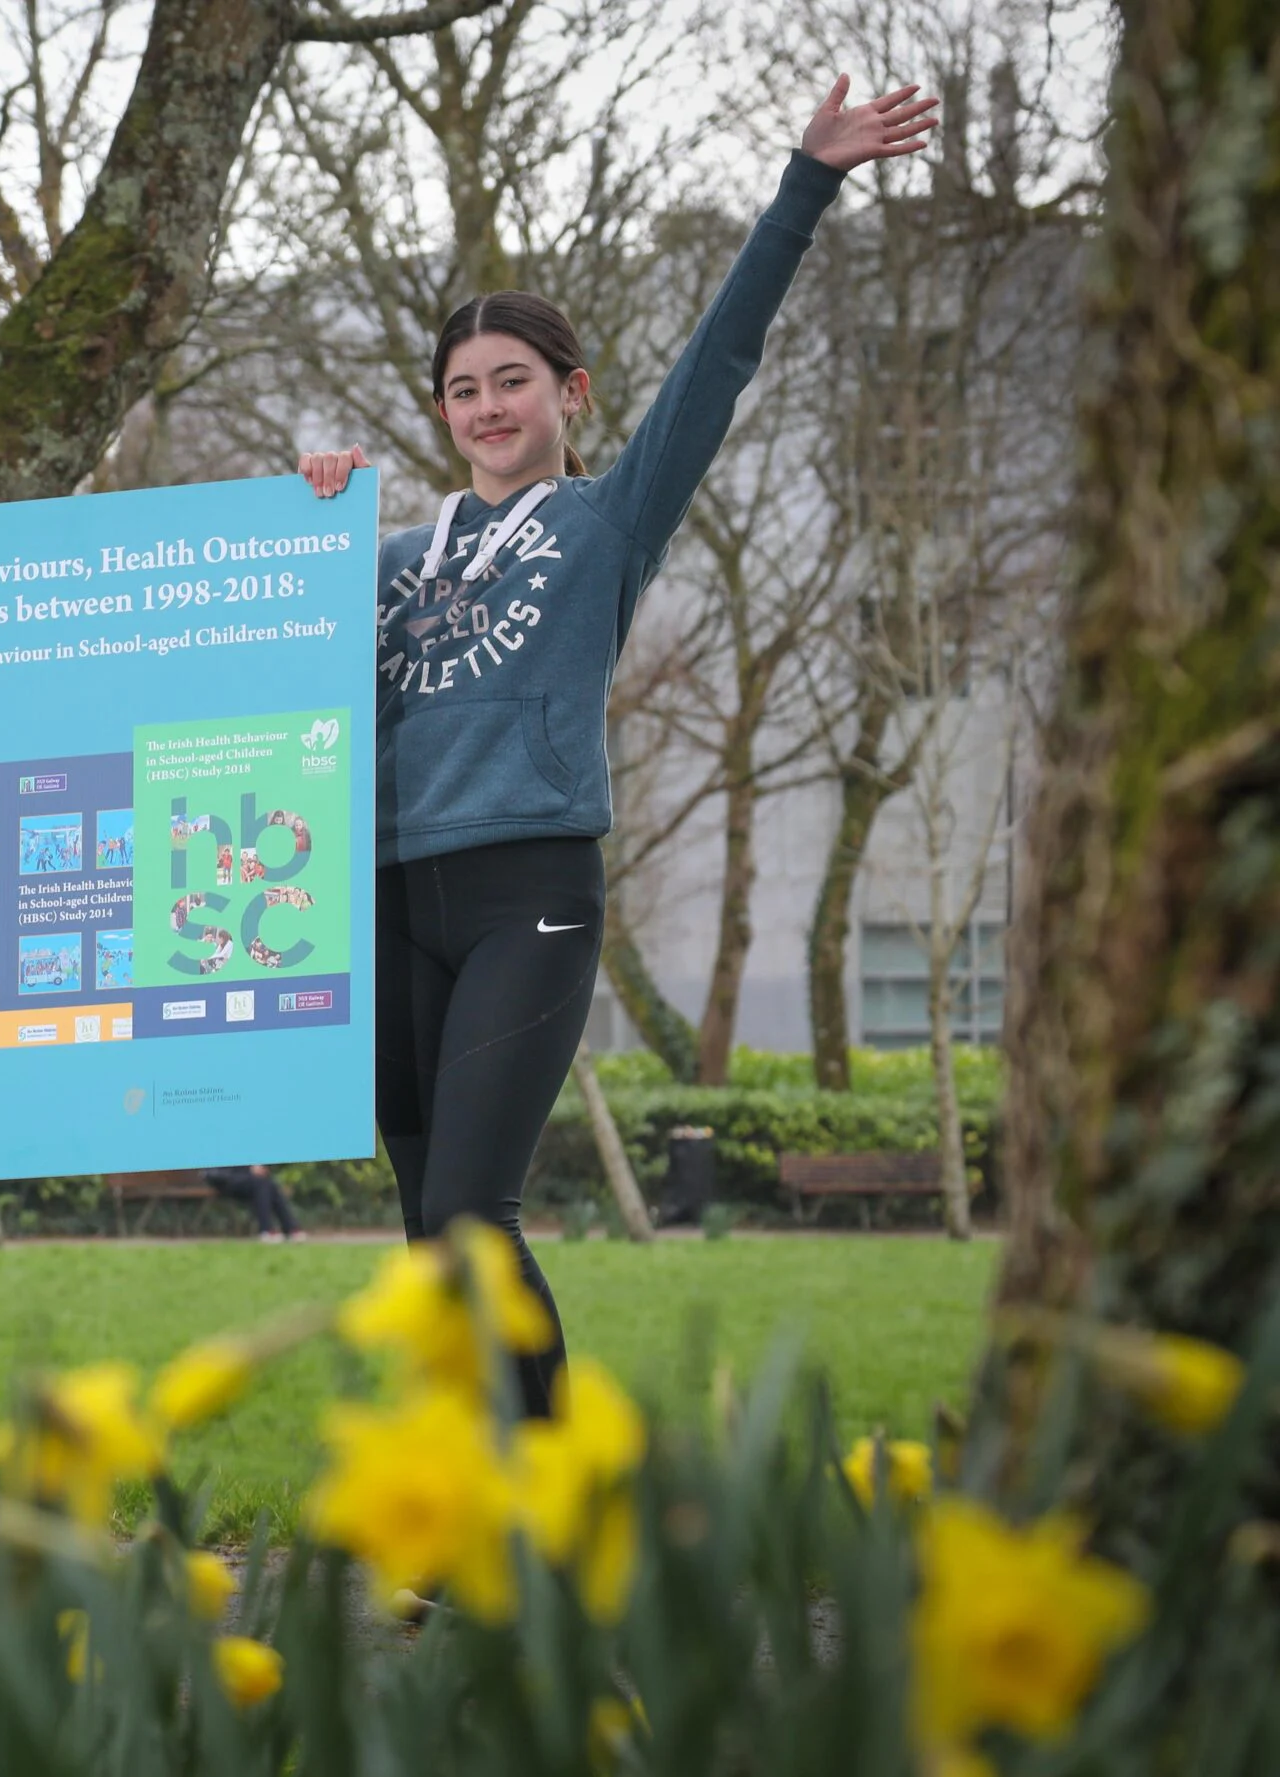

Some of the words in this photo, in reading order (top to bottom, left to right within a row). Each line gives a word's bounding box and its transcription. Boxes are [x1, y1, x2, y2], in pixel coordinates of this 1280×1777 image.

[100, 538, 195, 574] Health
[203, 531, 351, 563] Outcomes
[16, 593, 133, 622] between
[142, 572, 304, 610] 1998-2018:
[56, 642, 74, 659] in
[79, 630, 190, 658] School-aged
[195, 623, 277, 647] Children
[283, 617, 337, 640] Study
[146, 741, 166, 751] The
[168, 738, 193, 749] Irish
[195, 736, 231, 748] Health
[233, 732, 288, 744] Behaviour
[146, 756, 157, 767] in
[159, 751, 224, 765] School-aged
[226, 747, 273, 759] Children
[302, 755, 337, 767] hbsc
[146, 768, 189, 783] (HBSC)
[191, 766, 222, 779] Study
[224, 763, 251, 774] 2018
[19, 885, 36, 895] The
[38, 883, 60, 894] Irish
[63, 880, 95, 892] Health
[18, 900, 28, 910] in
[30, 896, 88, 909] School-aged
[90, 892, 133, 904] Children
[18, 911, 57, 926] (HBSC)
[59, 910, 87, 922] Study
[89, 908, 113, 919] 2014
